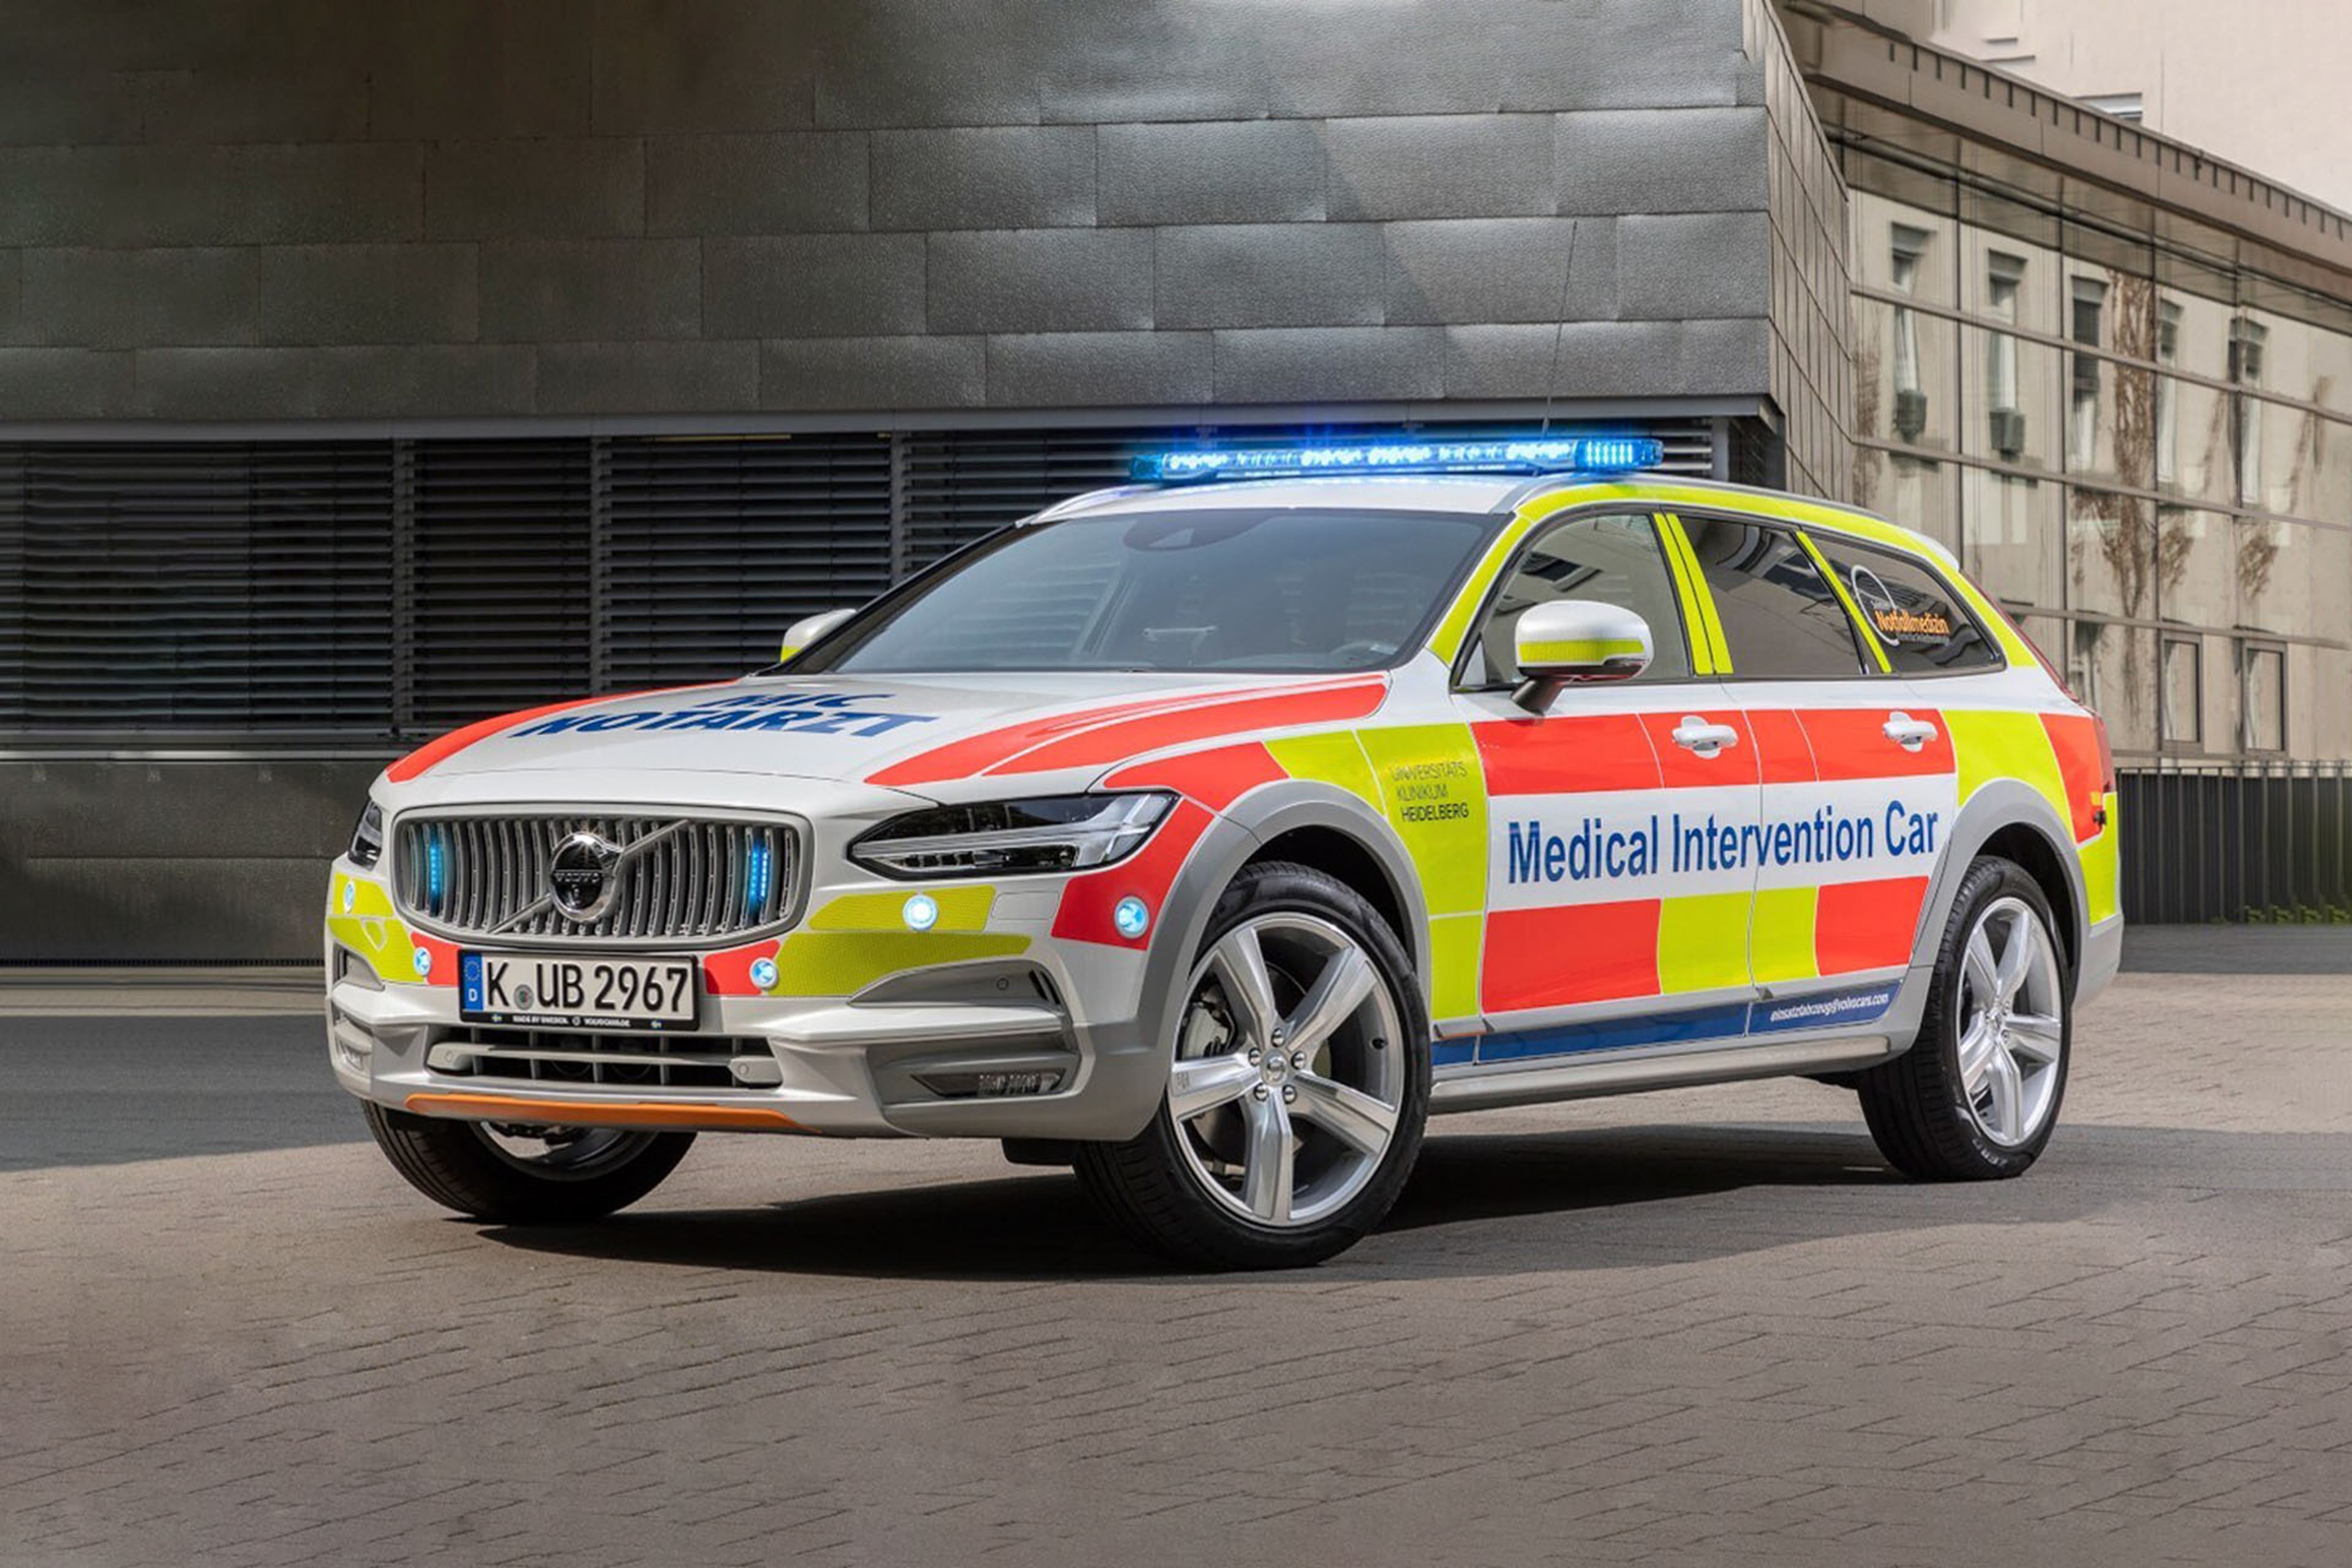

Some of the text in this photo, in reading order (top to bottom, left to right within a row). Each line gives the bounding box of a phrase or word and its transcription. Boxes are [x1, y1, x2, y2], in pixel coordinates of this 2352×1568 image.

[694, 693, 895, 708] MIC
[507, 710, 940, 738] NOTARZT
[1397, 784, 1448, 801] KLINIKUM
[1401, 802, 1469, 822] HEIDELBERG
[1507, 800, 1939, 884] Medical Intervention Car
[554, 873, 600, 883] VOLVO
[469, 988, 478, 1001] D
[487, 962, 688, 1012] K UB 2967
